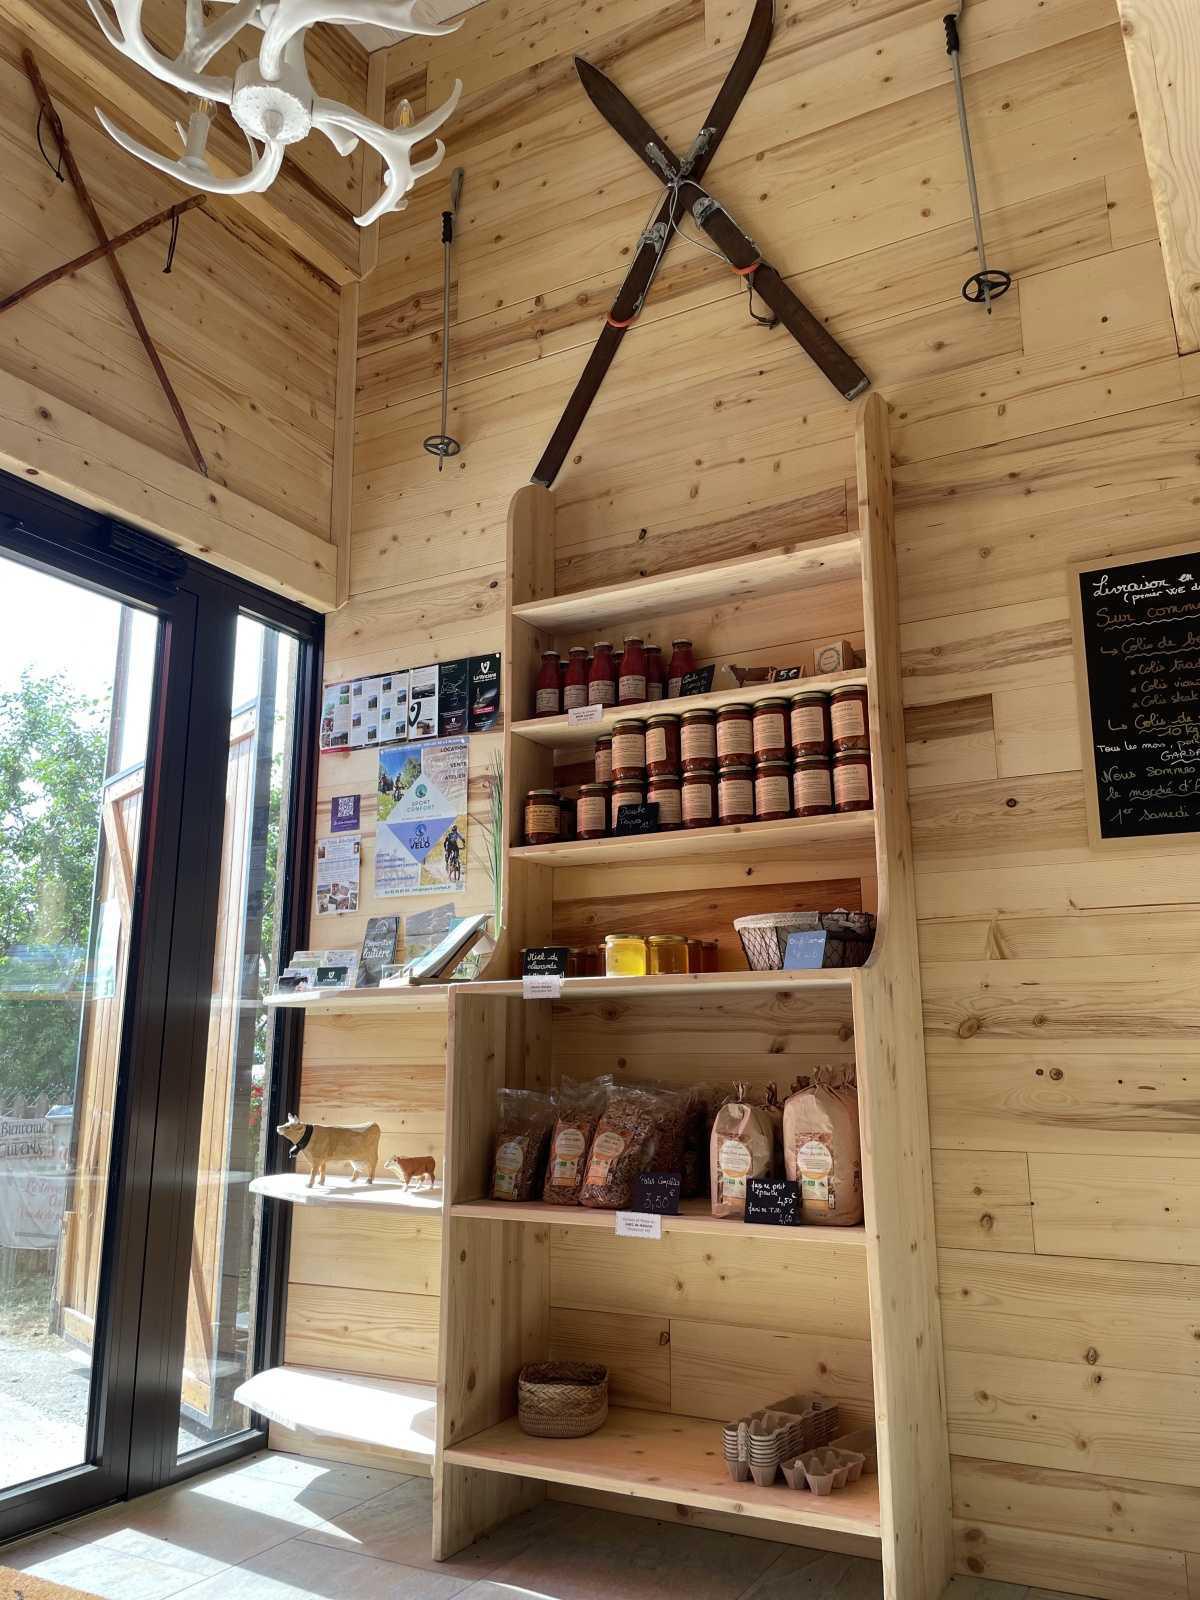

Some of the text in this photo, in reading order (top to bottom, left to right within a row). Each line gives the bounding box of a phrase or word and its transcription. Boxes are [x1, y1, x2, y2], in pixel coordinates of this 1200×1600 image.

[1092, 575, 1170, 597] Livraison
[1096, 608, 1136, 627] Sur
[440, 744, 468, 753] LOCATION
[444, 773, 466, 781] ATELIER
